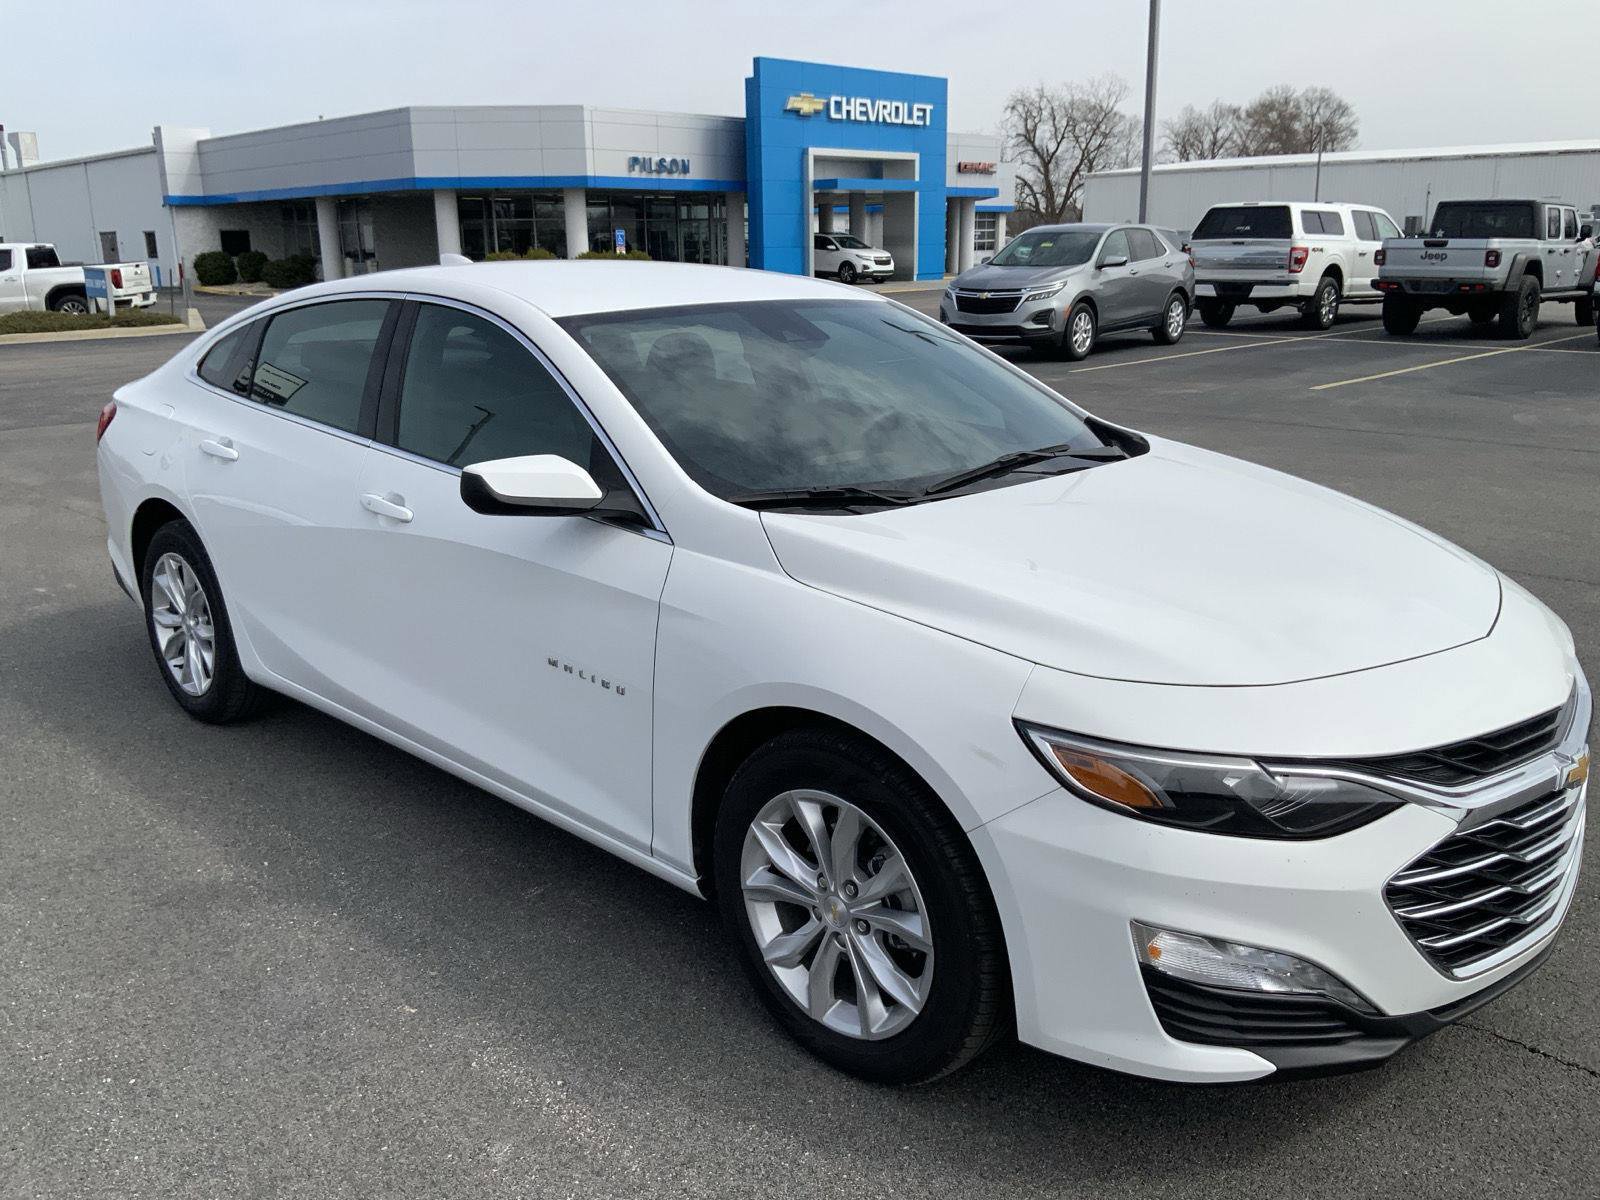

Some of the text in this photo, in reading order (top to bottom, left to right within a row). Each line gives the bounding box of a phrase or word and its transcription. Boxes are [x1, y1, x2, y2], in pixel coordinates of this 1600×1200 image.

[829, 95, 934, 126] CHEVROLET
[628, 156, 690, 175] PILSON
[1420, 250, 1448, 262] Jeep
[547, 656, 626, 696] MALIBU
